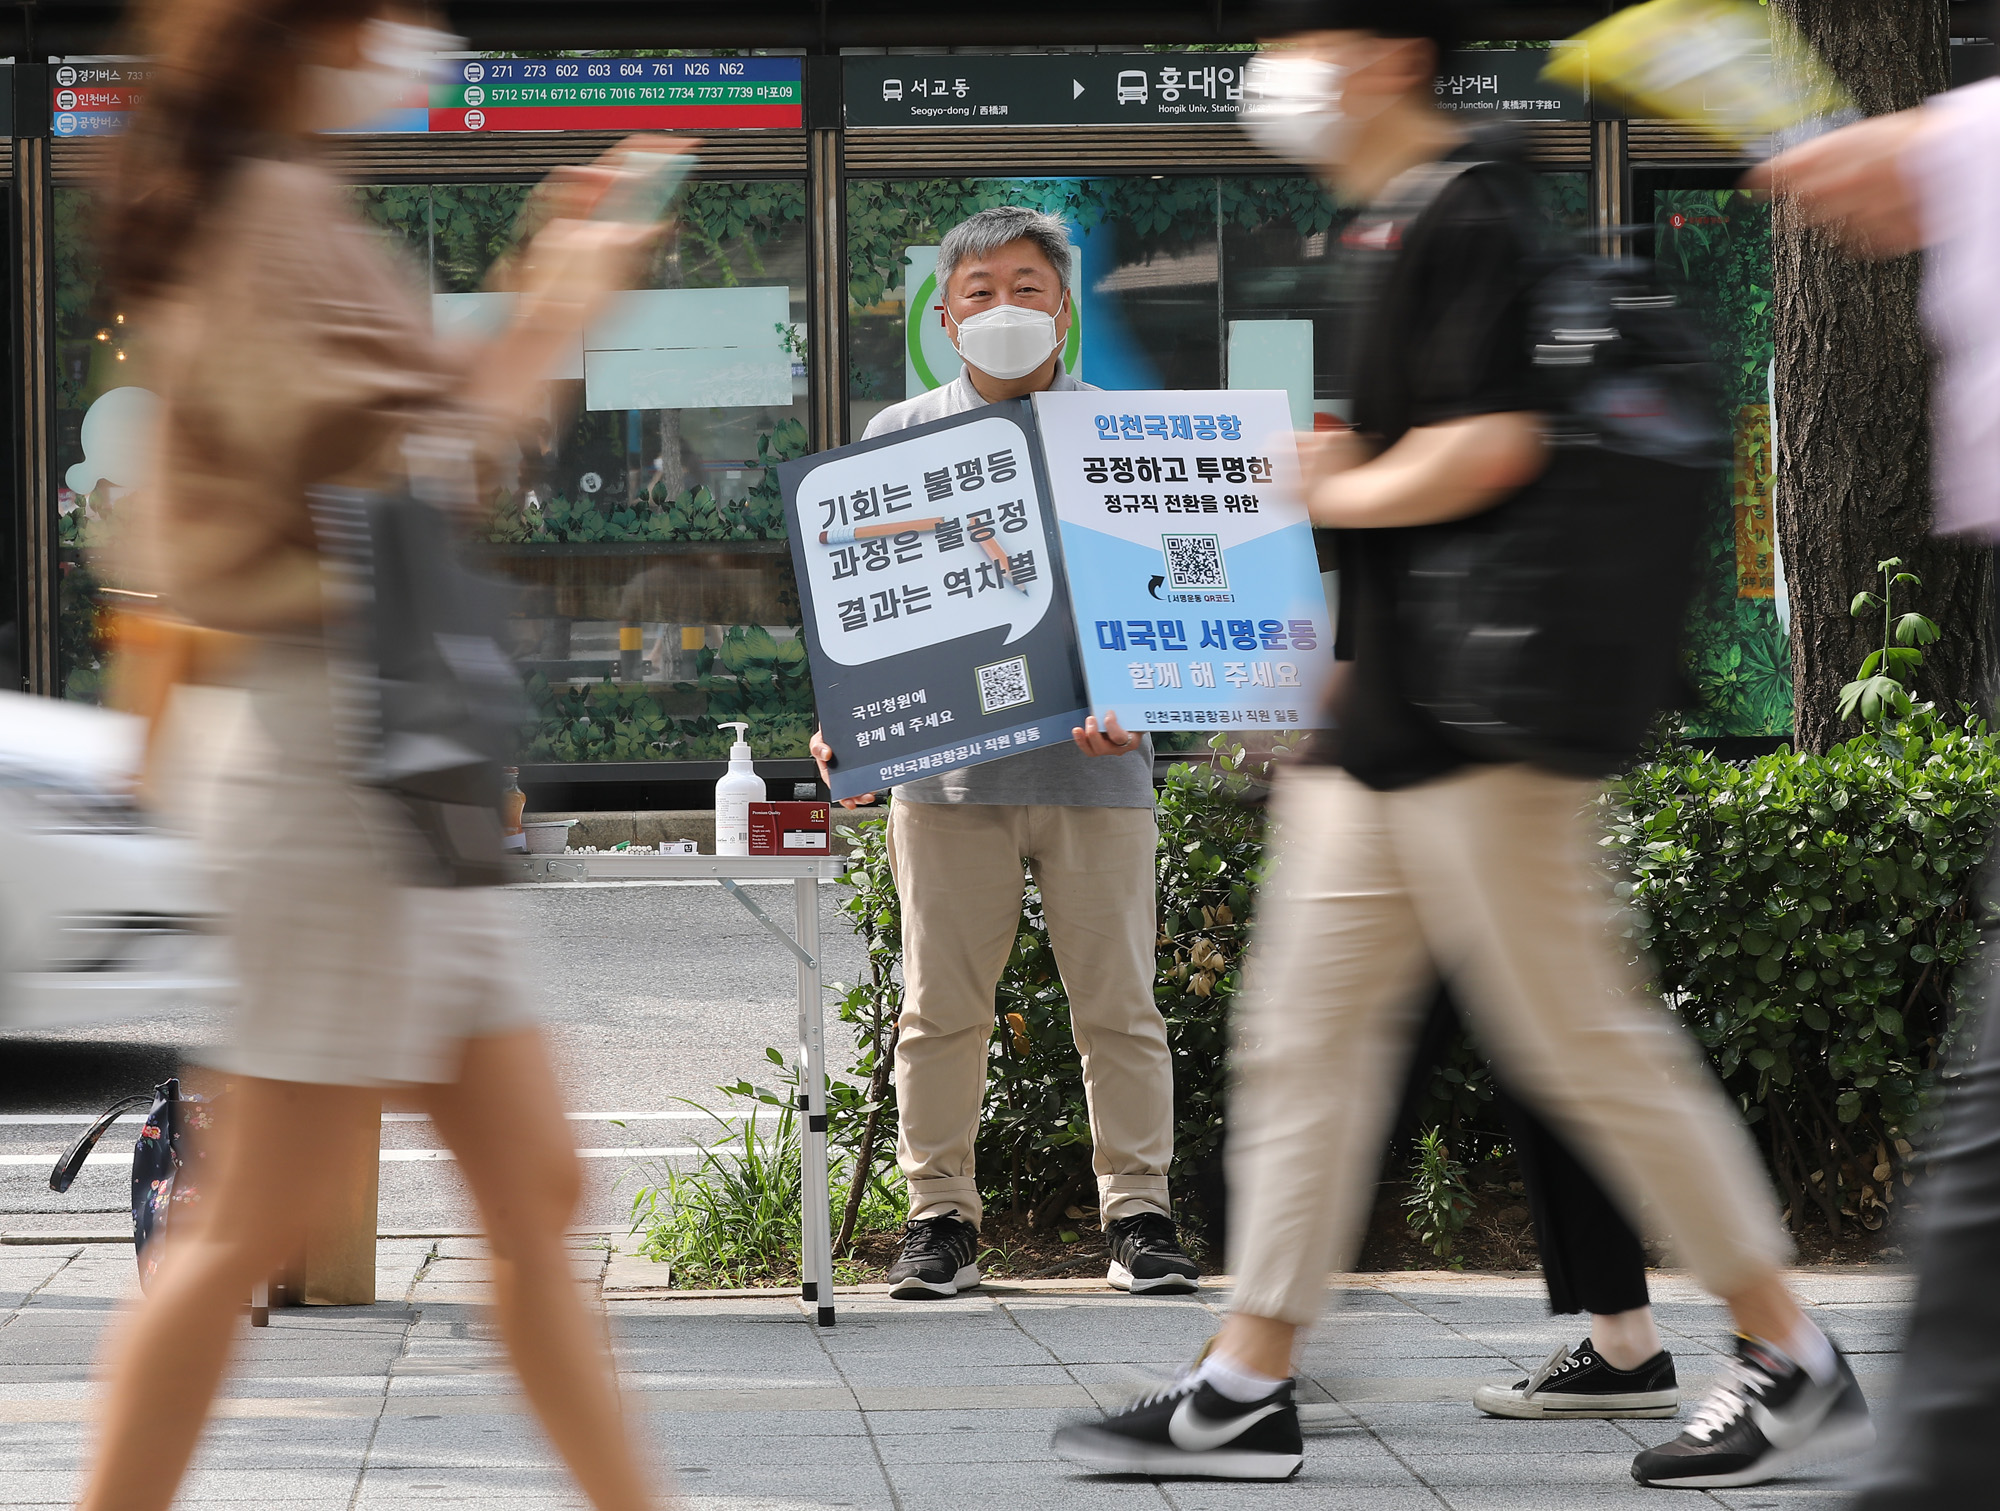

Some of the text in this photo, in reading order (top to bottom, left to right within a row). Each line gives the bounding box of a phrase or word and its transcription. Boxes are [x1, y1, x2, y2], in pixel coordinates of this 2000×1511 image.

[78, 70, 121, 82] 경기버스
[127, 72, 143, 80] 733
[491, 63, 745, 78] 271 273 602 603 604 761 N26 N62
[492, 86, 793, 100] 5712 5714 6712 6716 7016 7612 7734 7737 7739 마포09
[910, 78, 970, 98] 서교동
[1155, 66, 1273, 102] 홍대입구
[1432, 74, 1498, 94] 동삼거리
[78, 93, 122, 106] 인천버스
[1158, 104, 1187, 115] Hongik
[1188, 104, 1209, 114] Univ.
[1212, 104, 1240, 113] Station
[1434, 100, 1458, 111] -dong
[1459, 100, 1494, 110] Junction
[910, 105, 970, 116] Seogyo-dong
[979, 105, 1008, 116] 西橋洞
[78, 116, 122, 129] 공항버스
[1094, 414, 1242, 441] 인천국제공항
[1082, 456, 1273, 484] 공정하고 투명한
[818, 448, 1017, 530] 기회는 불평등
[1103, 494, 1260, 514] 정규직 전환을 위한
[828, 498, 1028, 581] 과정은 불공정
[837, 549, 1038, 633] 결과는 역차별
[1094, 619, 1318, 651] 대국민 서명운동
[1127, 661, 1302, 690] 함께 해 주세요
[851, 688, 928, 721] 국민청원에
[1144, 709, 1300, 724] 인천국제공항공사 직원 일동
[855, 709, 955, 748] 함께 해 주세요
[879, 726, 1041, 781] 인천국제공항공사 직원 일동
